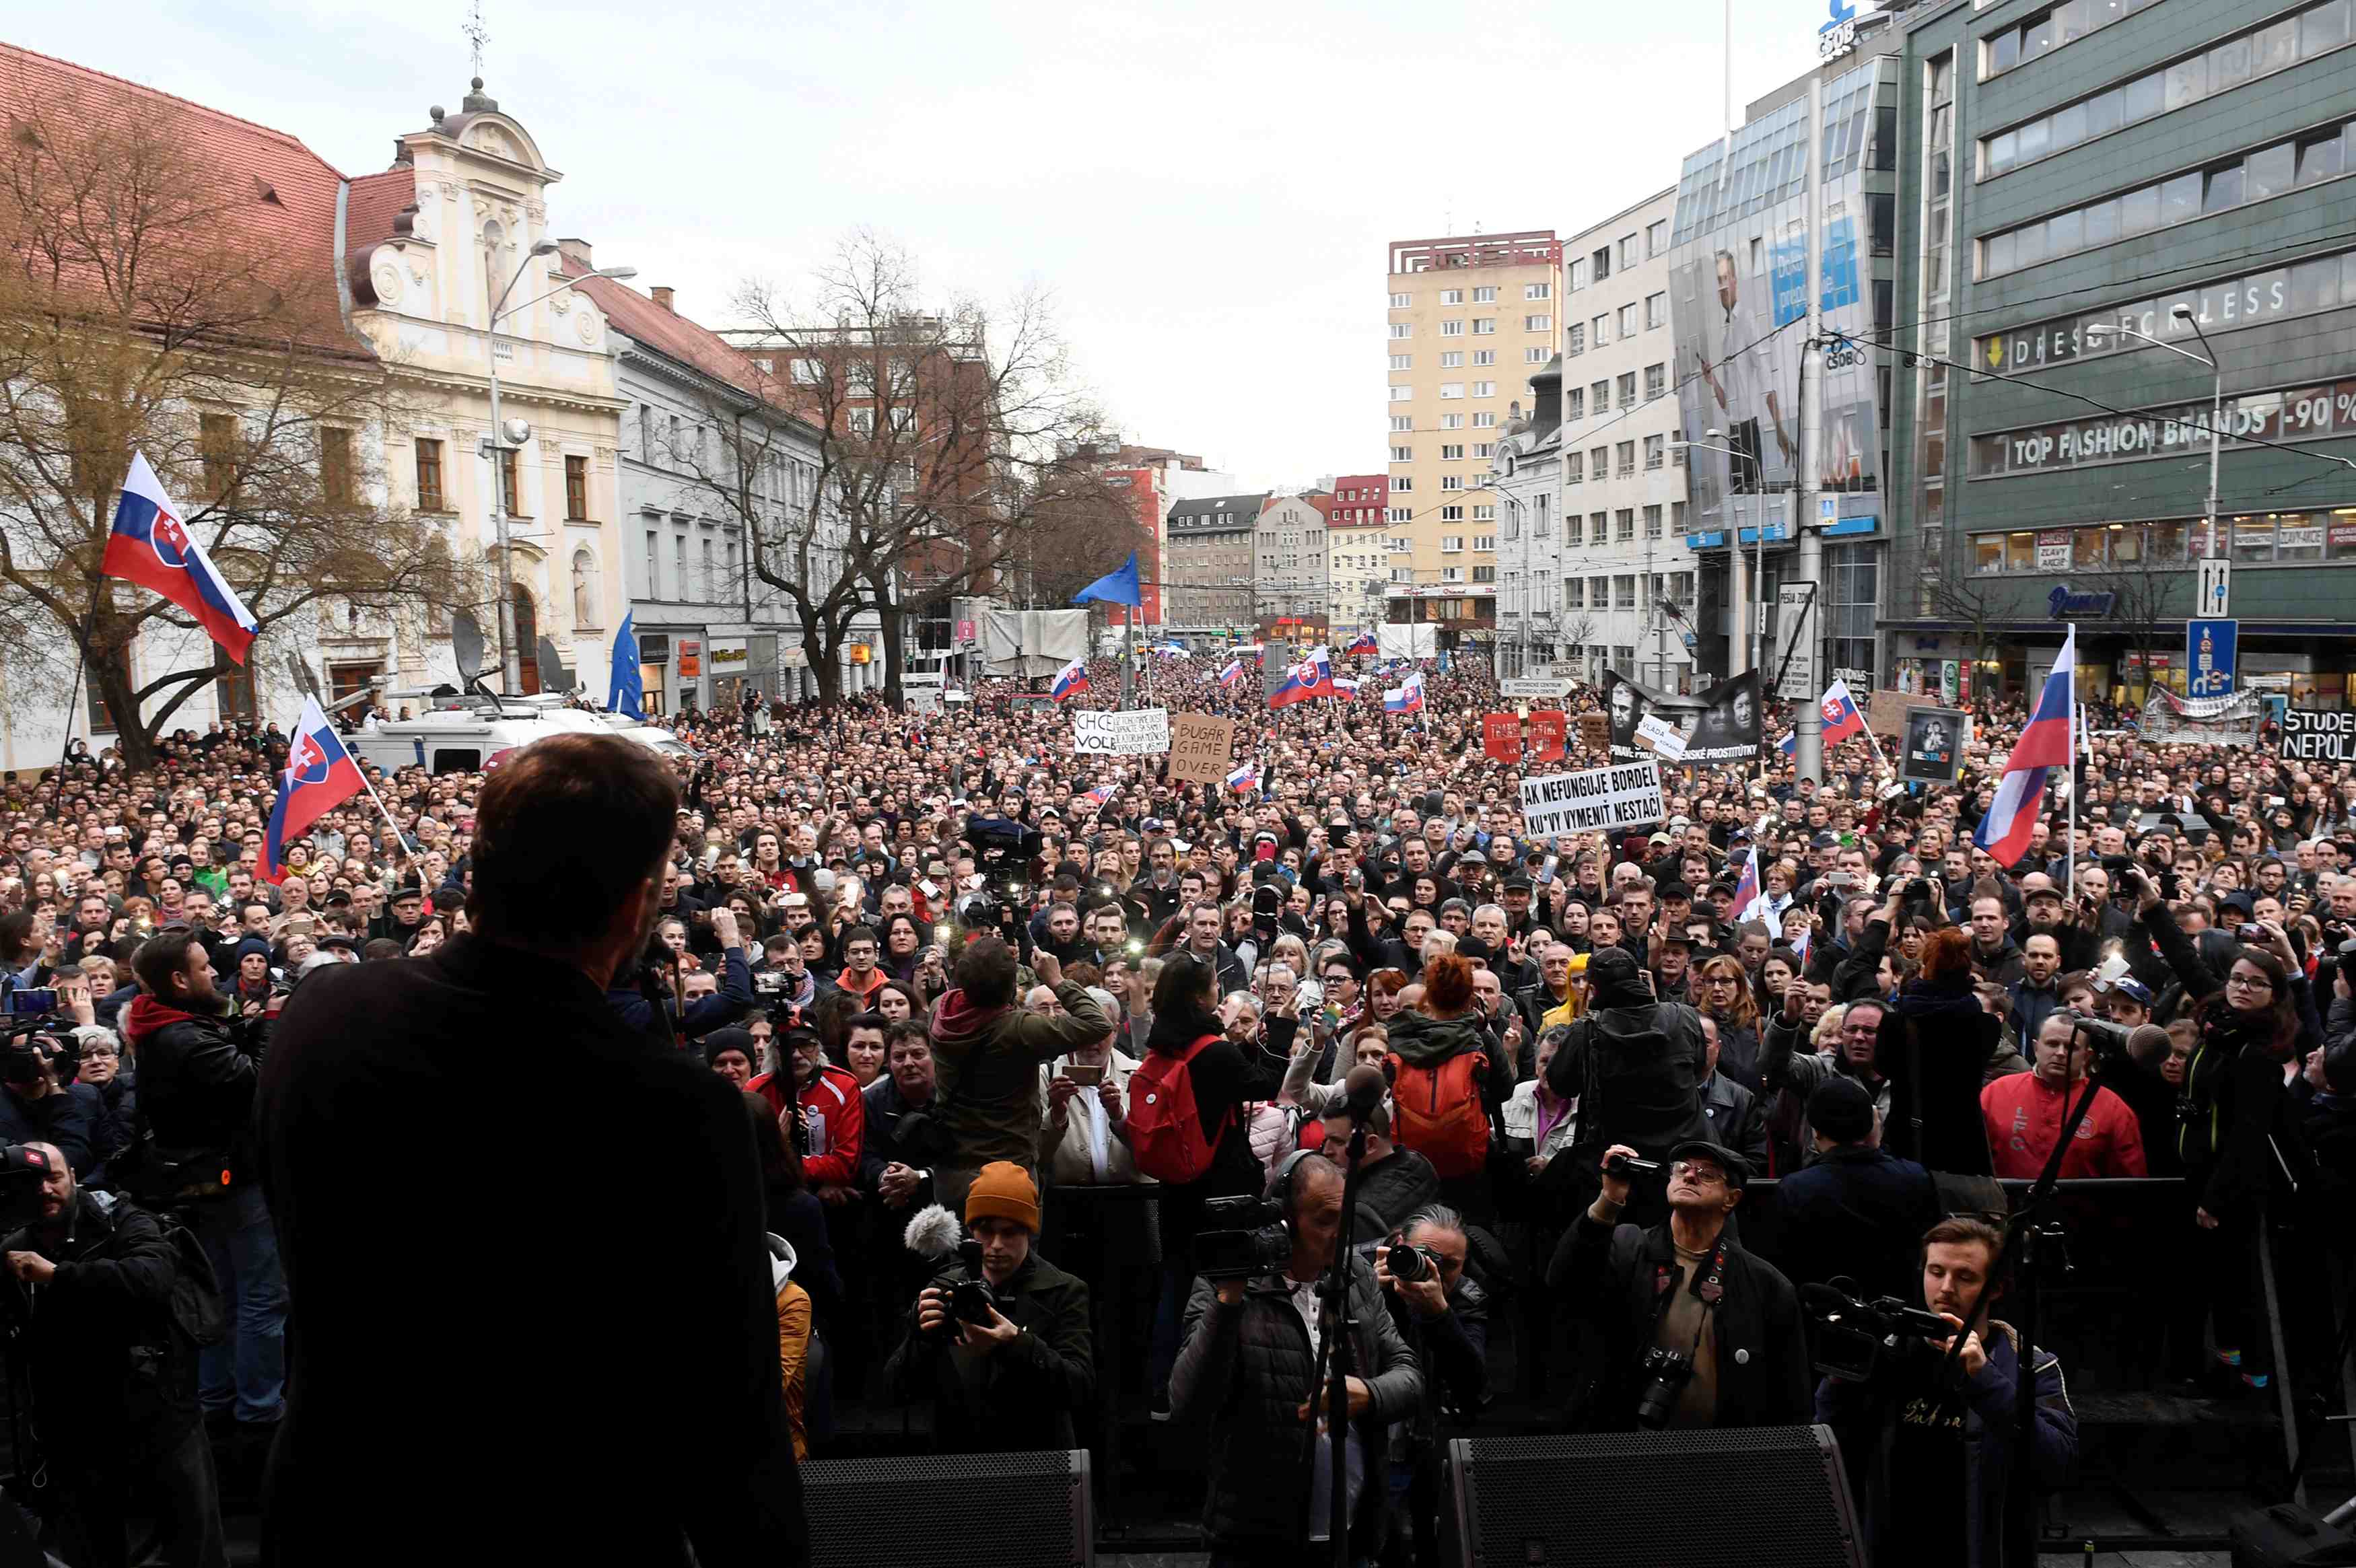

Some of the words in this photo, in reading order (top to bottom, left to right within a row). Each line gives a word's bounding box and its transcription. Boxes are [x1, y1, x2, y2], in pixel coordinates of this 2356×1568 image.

[2200, 281, 2283, 323] LESS
[2015, 437, 2052, 464] TOP
[2059, 423, 2154, 459] FASHION
[2163, 406, 2266, 445] BRANDS
[2285, 398, 2329, 428] -90
[2285, 709, 2356, 732] STUDE
[1180, 723, 1226, 742] BUGÁR
[1178, 742, 1222, 756] GAME
[1706, 743, 1758, 759] PROSTITÚTKY
[1177, 759, 1220, 775] OVER
[1525, 784, 1540, 806] AK
[1542, 774, 1609, 803] NEFUNGUJE
[1612, 766, 1657, 792] BORDEL
[1564, 799, 1610, 830] VYMENIŤ
[1614, 791, 1662, 822] NESTAČÍ
